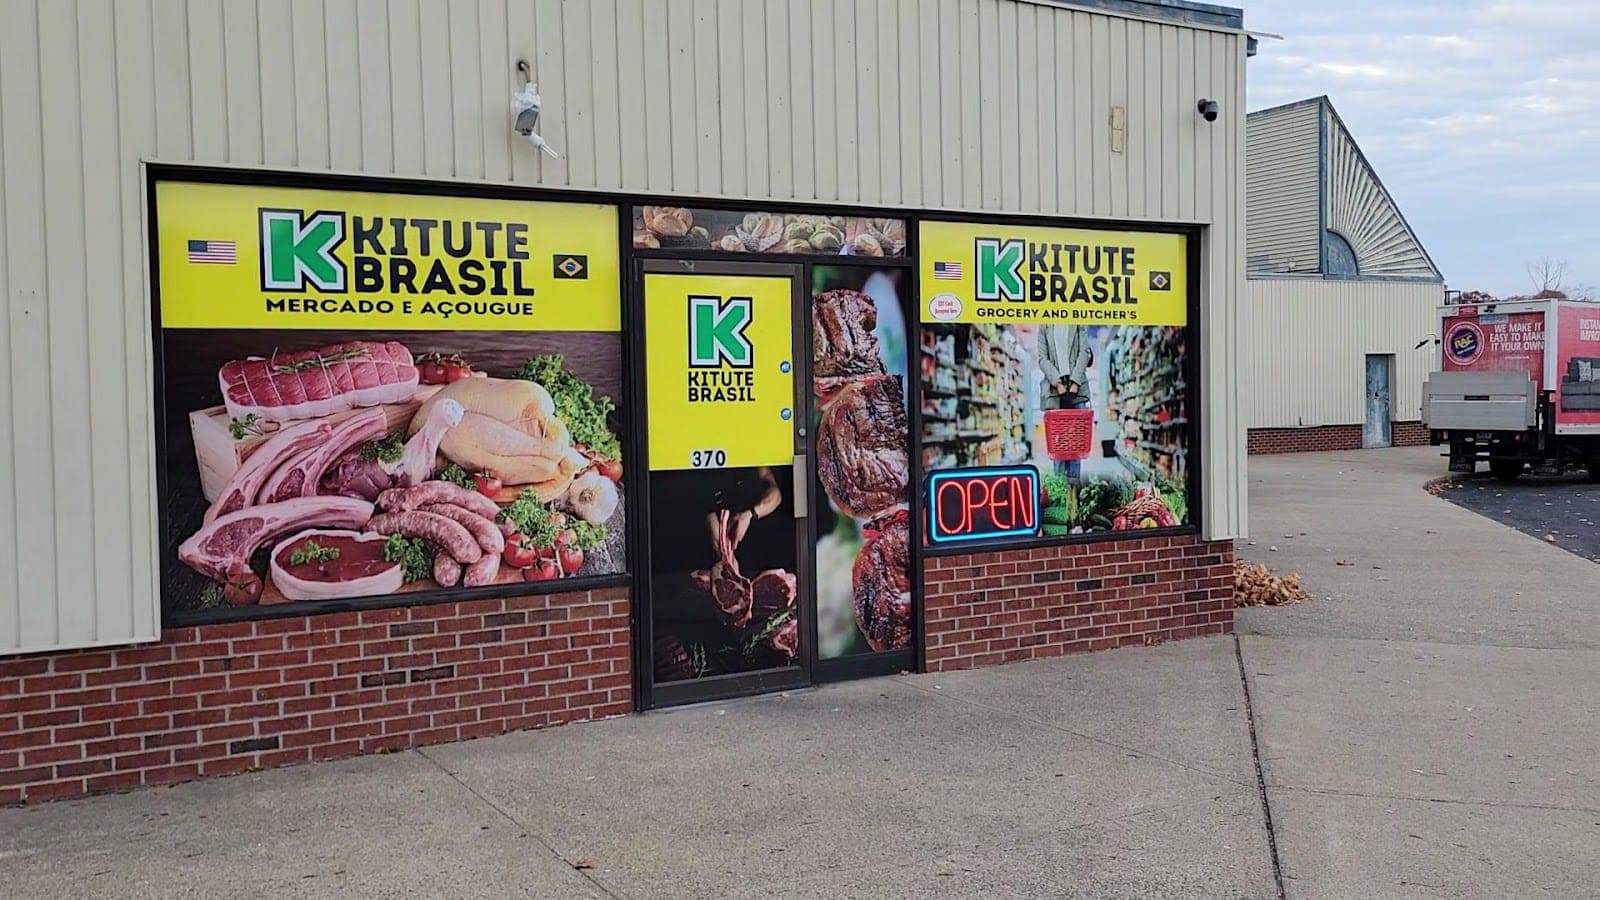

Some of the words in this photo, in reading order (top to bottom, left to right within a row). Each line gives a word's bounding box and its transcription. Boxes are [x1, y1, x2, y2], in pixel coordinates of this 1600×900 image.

[258, 207, 348, 293] K
[352, 215, 530, 260] KITUTE
[975, 237, 1026, 303] K
[1029, 242, 1136, 276] KITUTE
[353, 256, 535, 297] BRASIL
[1029, 273, 1138, 304] BRASIL
[265, 298, 395, 315] MERCADO
[402, 300, 413, 315] E
[419, 301, 534, 320] AÇOUGUE
[976, 307, 1039, 319] GROCERY
[1042, 308, 1069, 319] AND
[1072, 310, 1137, 320] BUTCHER'S
[688, 295, 754, 368] K
[1490, 333, 1508, 342] EASY
[1511, 332, 1520, 342] TO
[1494, 324, 1506, 333] WE
[1509, 322, 1532, 333] MAKE
[1534, 322, 1542, 331] IT
[1491, 343, 1498, 352] IT
[1501, 342, 1521, 351] YOUR
[1523, 341, 1545, 351] OWN
[688, 371, 754, 387] KITUTE
[688, 387, 755, 402] BRASIL
[692, 450, 726, 467] 370
[937, 477, 1032, 534] OPEN
